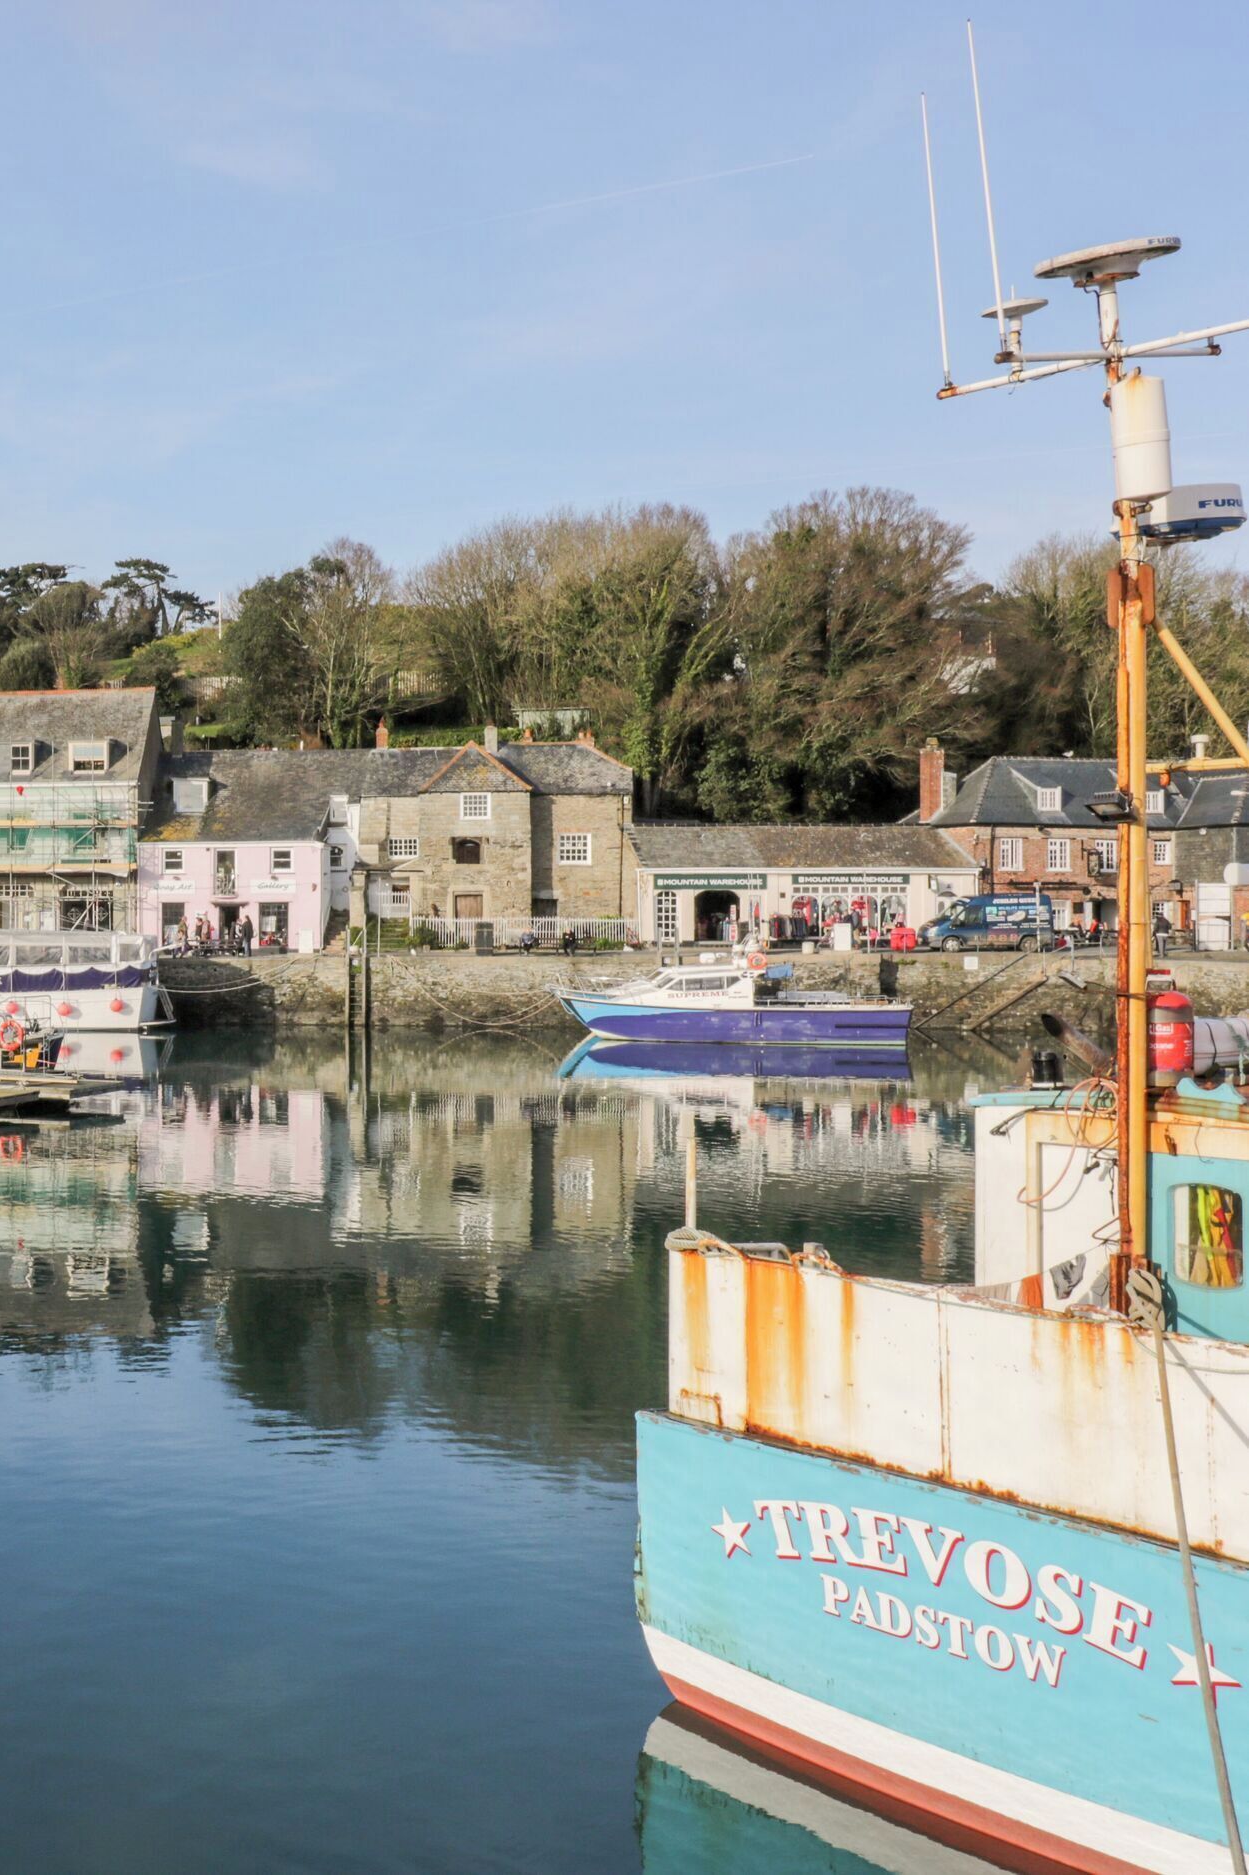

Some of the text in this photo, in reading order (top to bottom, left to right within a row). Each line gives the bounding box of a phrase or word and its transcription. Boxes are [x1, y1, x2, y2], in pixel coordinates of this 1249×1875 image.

[667, 991, 729, 999] SUPREME
[752, 1498, 1152, 1670] TREVOSE
[819, 1572, 1067, 1689] PADSTOW
